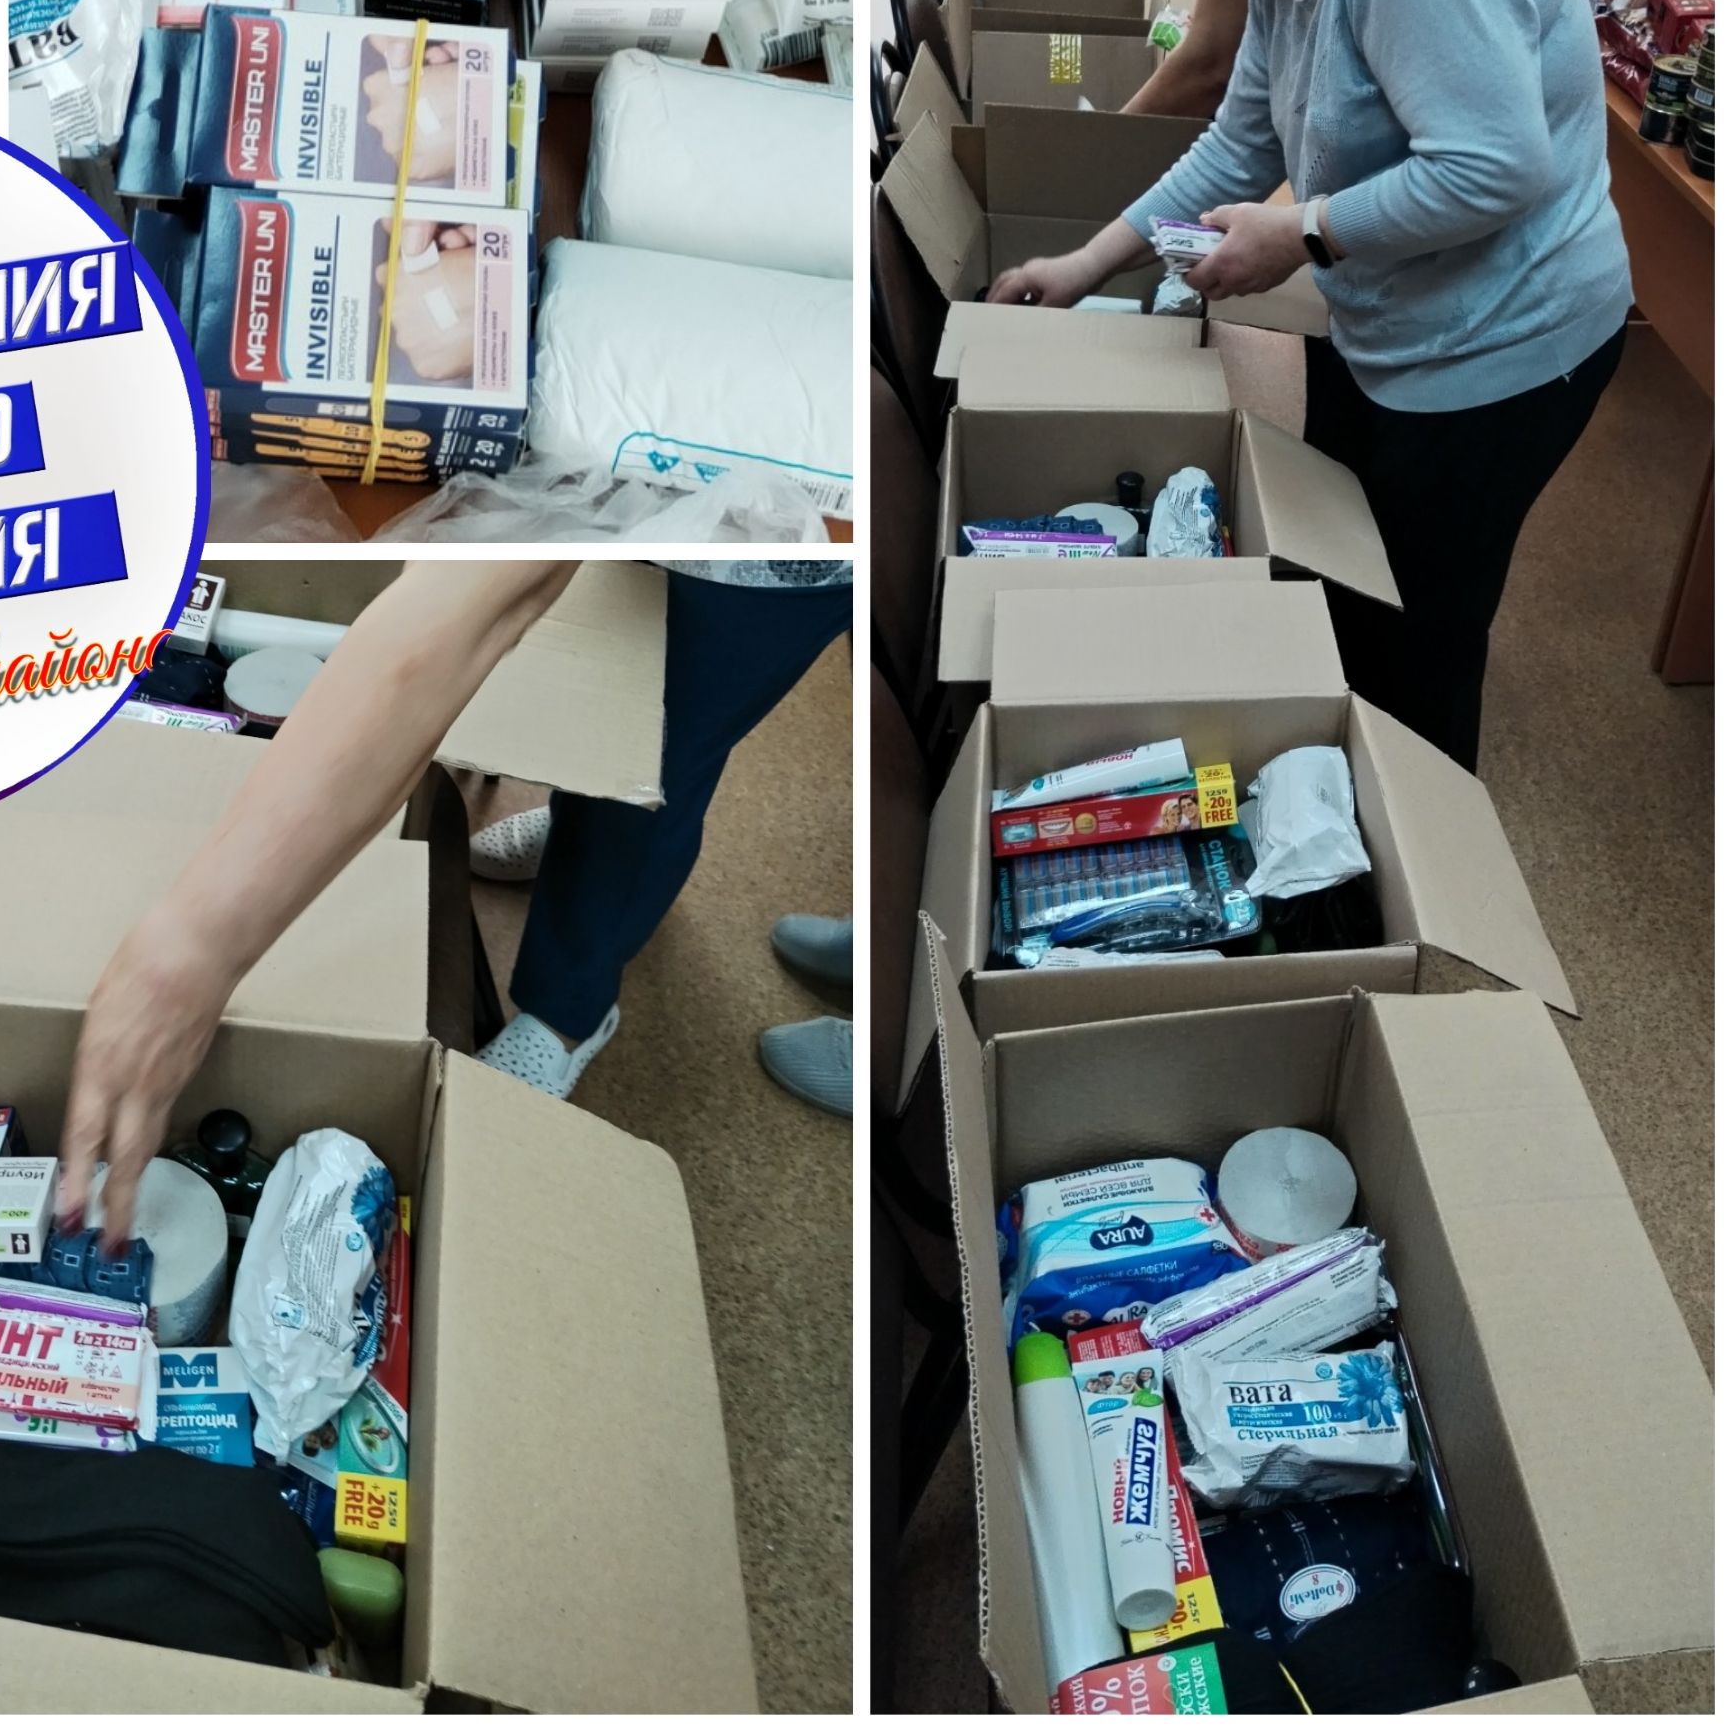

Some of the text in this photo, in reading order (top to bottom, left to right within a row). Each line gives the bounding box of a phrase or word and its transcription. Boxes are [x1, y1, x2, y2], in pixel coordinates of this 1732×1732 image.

[466, 48, 482, 72] 20
[239, 26, 270, 172] MASTER UNI
[297, 59, 323, 180] INVISIBLE
[483, 231, 500, 257] 20
[244, 210, 278, 373] MASTER UNI
[306, 246, 332, 380] INVISIBLE
[1204, 808, 1234, 824] FREE
[1207, 839, 1232, 889] СТАНОК
[1097, 1224, 1147, 1245] AURA
[1125, 1260, 1178, 1276] САЛФЕТКИ
[163, 1365, 215, 1377] MELIGEN
[1304, 1403, 1332, 1420] 100
[1236, 1425, 1338, 1443] стерильная
[344, 1478, 365, 1527] FREE
